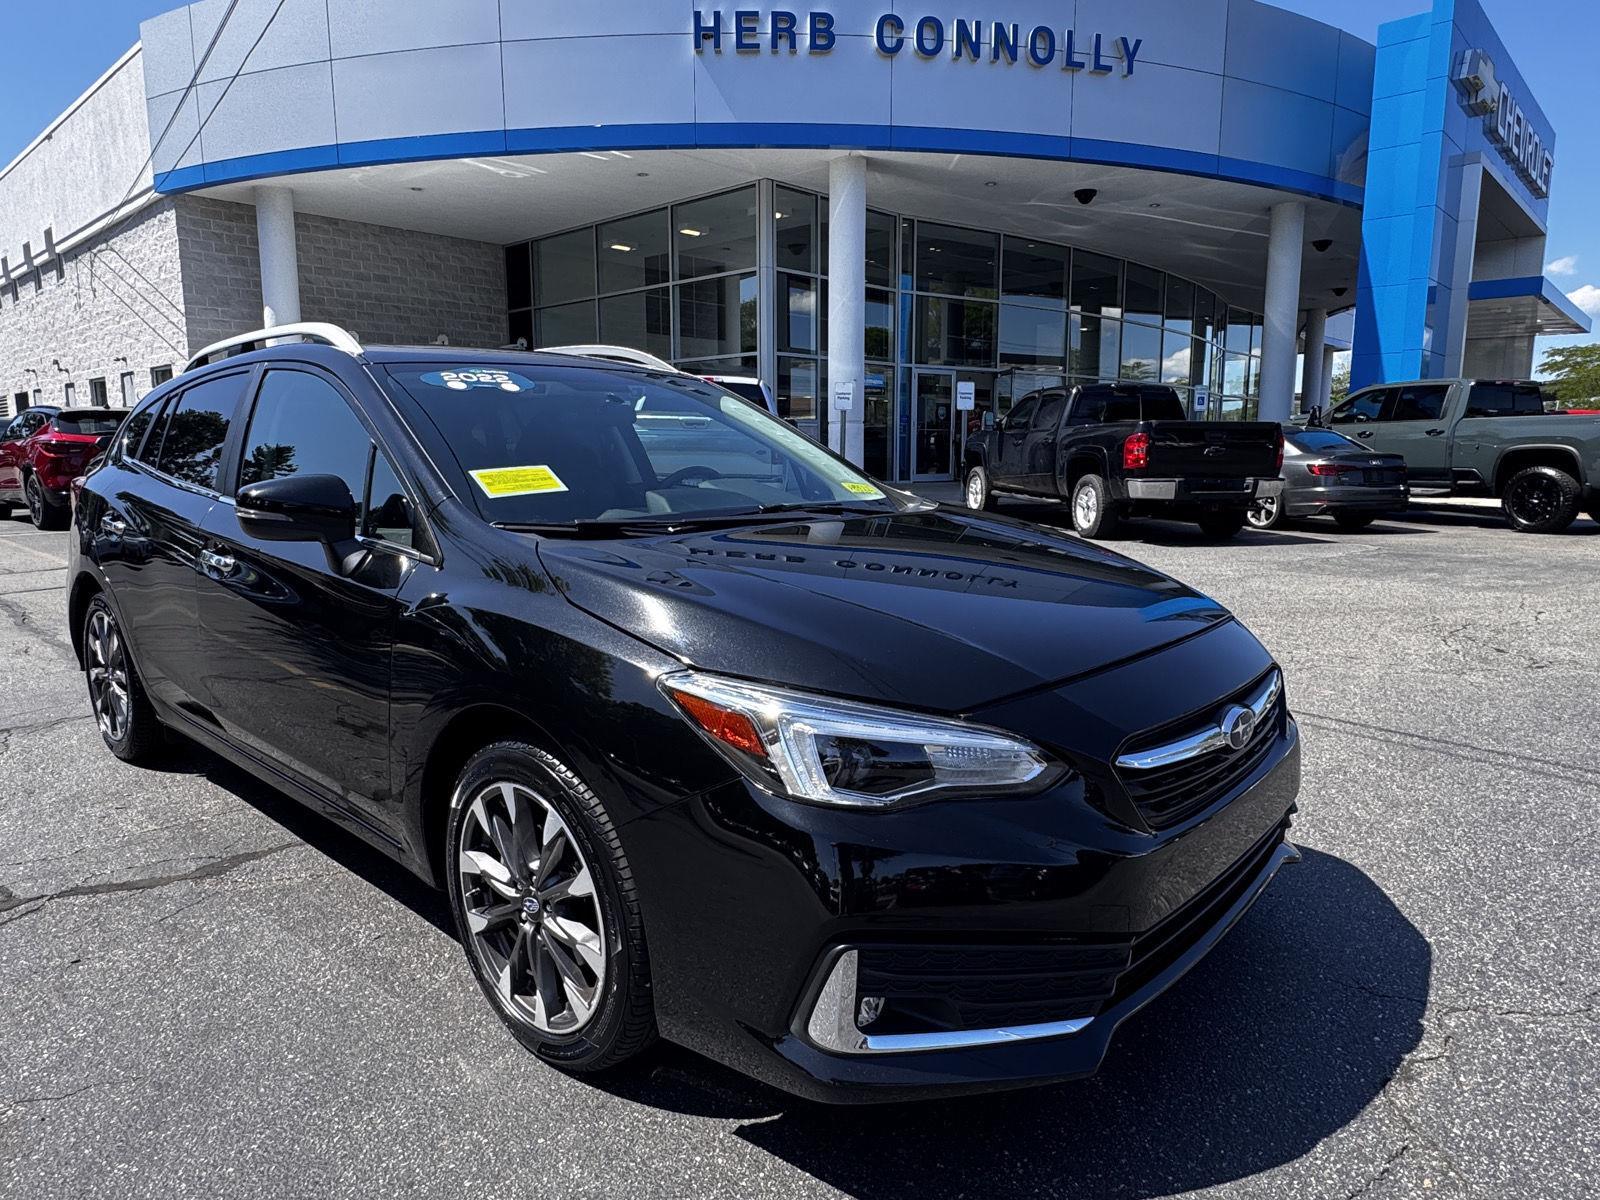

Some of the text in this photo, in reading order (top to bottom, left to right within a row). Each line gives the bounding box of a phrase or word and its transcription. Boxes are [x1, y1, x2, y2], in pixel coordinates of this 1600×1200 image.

[694, 11, 1143, 77] HERB CONNOLLY
[440, 372, 513, 384] 2022
